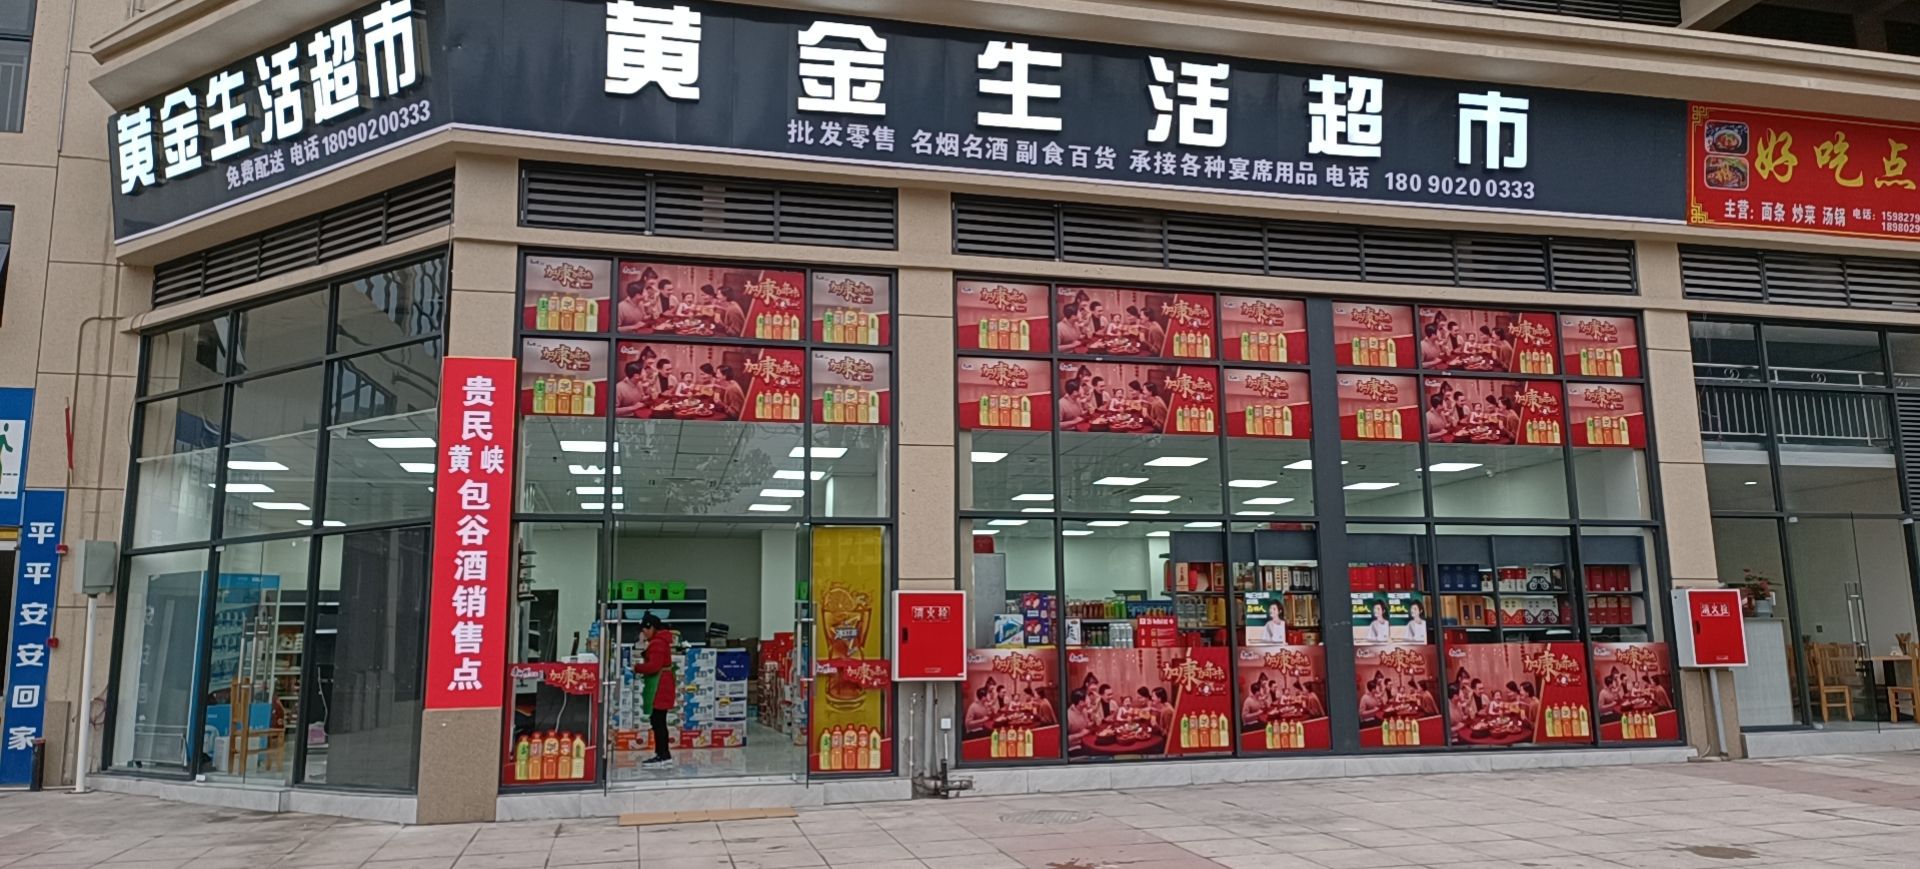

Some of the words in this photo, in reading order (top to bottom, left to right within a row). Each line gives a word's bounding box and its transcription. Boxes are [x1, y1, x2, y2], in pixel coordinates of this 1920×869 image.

[118, 0, 418, 194] 黄金生活超市
[604, 0, 1530, 170] 黄金生活超市
[226, 151, 285, 190] 免费配送
[289, 135, 320, 167] 电话
[321, 100, 431, 156] 18090200333
[787, 119, 896, 153] 批发零售
[910, 129, 1008, 162] 名烟名酒
[1015, 141, 1117, 170] 副食百货
[1128, 149, 1318, 187] 承接各种宴席用品
[1325, 165, 1370, 189] 电话
[1754, 127, 1917, 190] 好吃点
[1761, 201, 1786, 222] 面条
[1791, 203, 1816, 225] 炒菜
[1822, 206, 1846, 228] 汤锅
[7, 522, 56, 750] 平平安安回家
